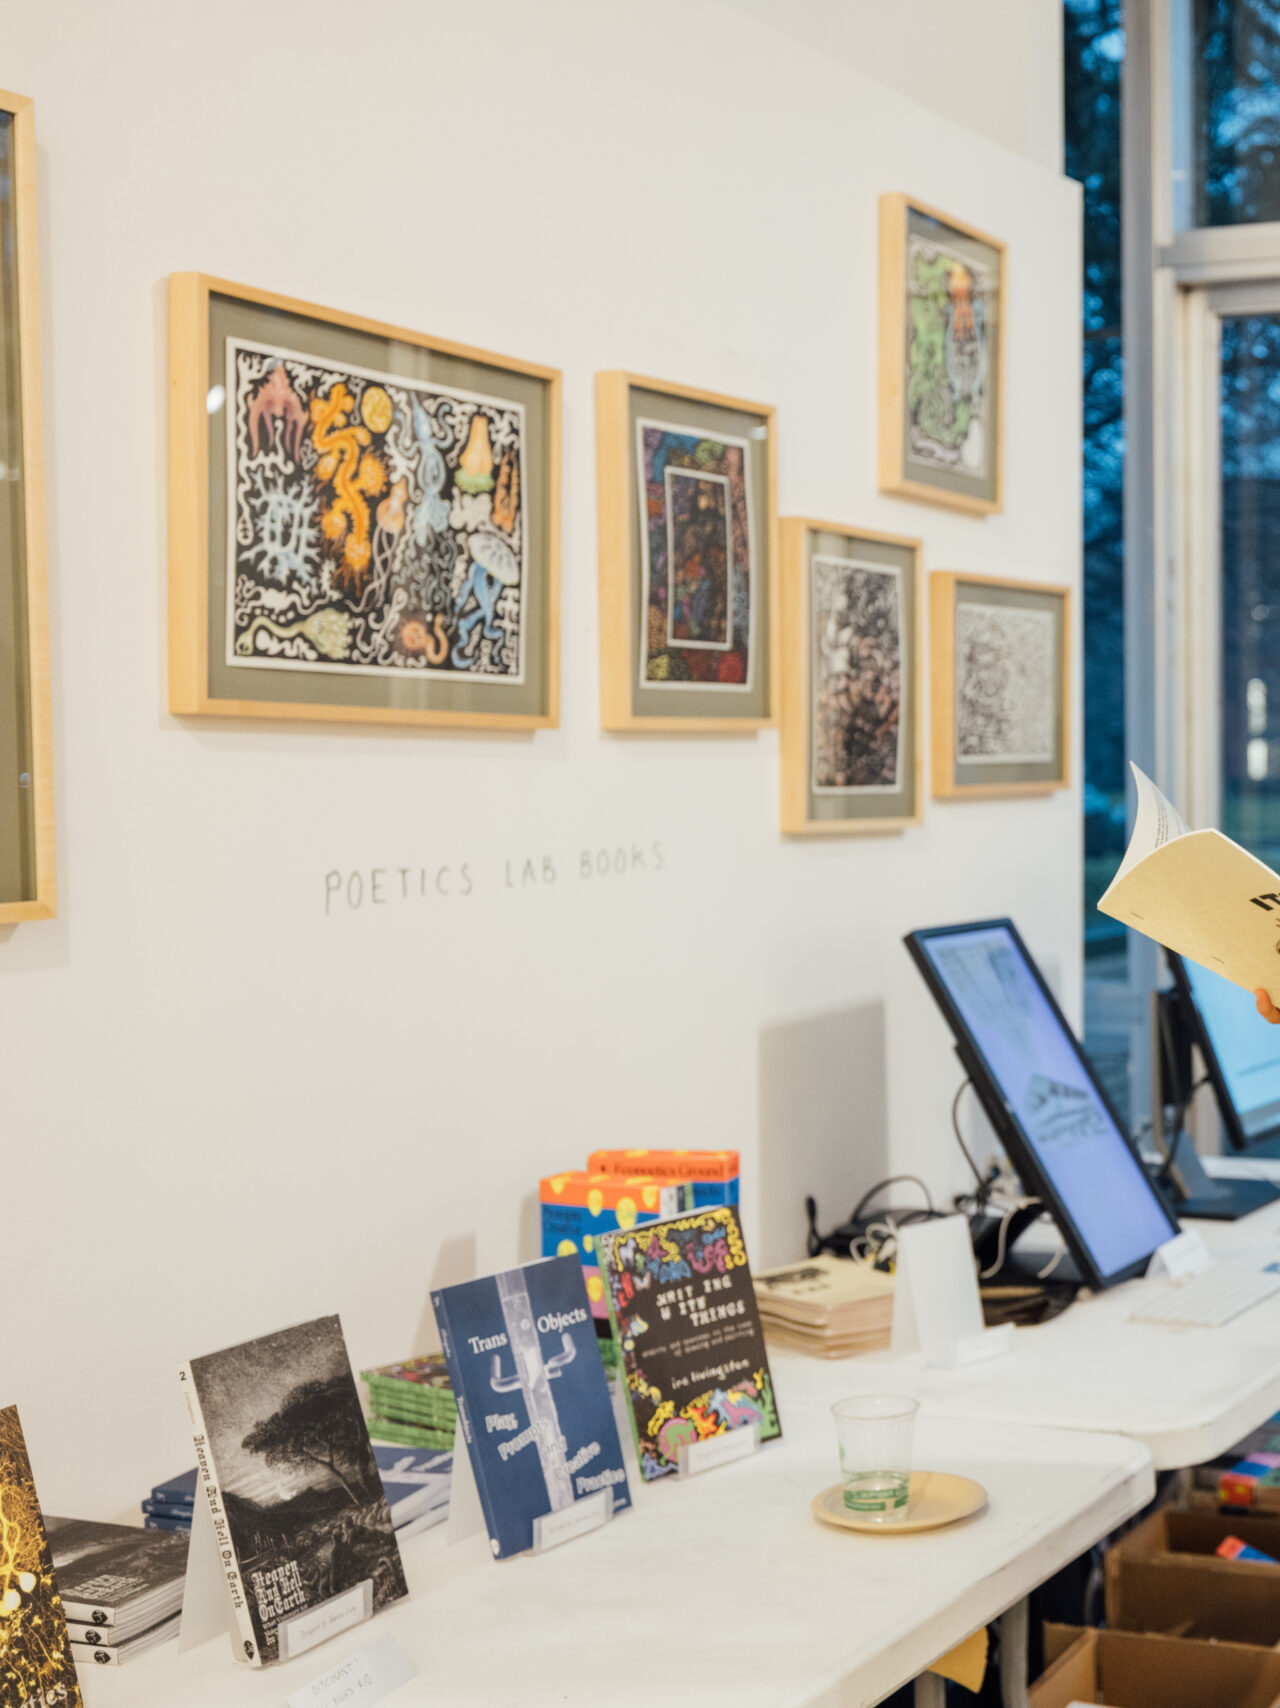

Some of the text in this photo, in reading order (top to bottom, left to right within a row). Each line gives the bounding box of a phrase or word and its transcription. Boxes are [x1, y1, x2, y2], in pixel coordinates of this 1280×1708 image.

[325, 839, 665, 915] POETICS LAB BOOKS
[537, 1308, 588, 1333] Objects
[689, 1299, 747, 1328] THINGS
[468, 1332, 508, 1354] Trans
[179, 1370, 188, 1381] 2
[690, 1358, 750, 1383] livingston
[194, 1434, 244, 1609] Heaven And Hell On Earth
[251, 1560, 298, 1588] Heaven
[254, 1571, 303, 1606] And Hell
[258, 1603, 277, 1622] On
[274, 1587, 306, 1615] Earth
